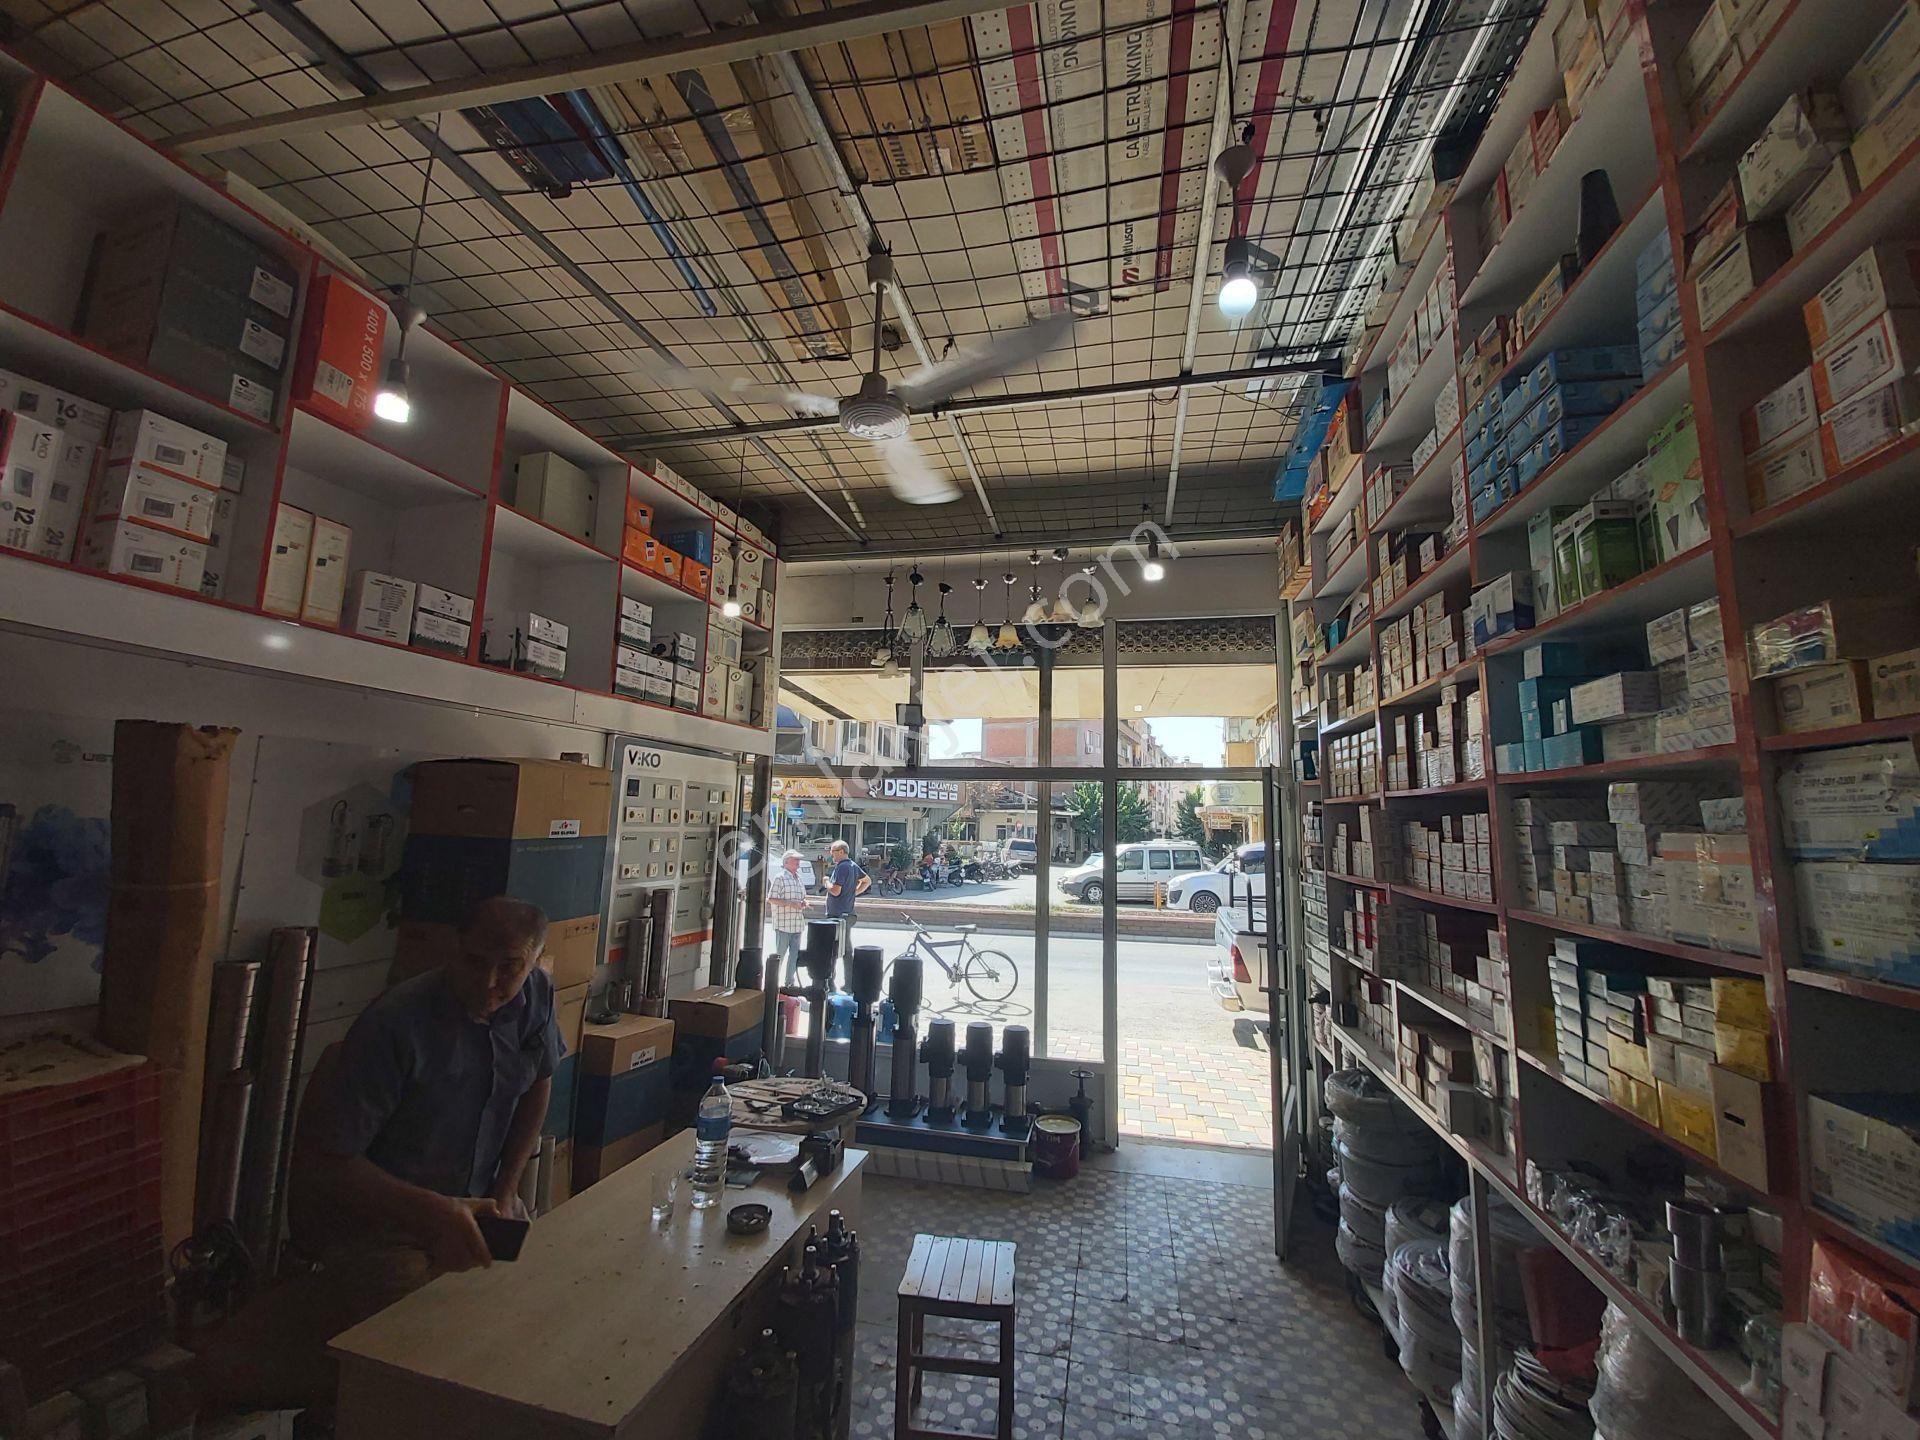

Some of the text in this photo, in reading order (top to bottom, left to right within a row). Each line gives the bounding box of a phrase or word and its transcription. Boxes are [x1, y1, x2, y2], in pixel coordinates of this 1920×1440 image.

[367, 308, 380, 334] 400
[361, 346, 375, 372] 500
[55, 397, 79, 420] 16
[13, 505, 36, 526] 12
[883, 778, 928, 799] DEDE
